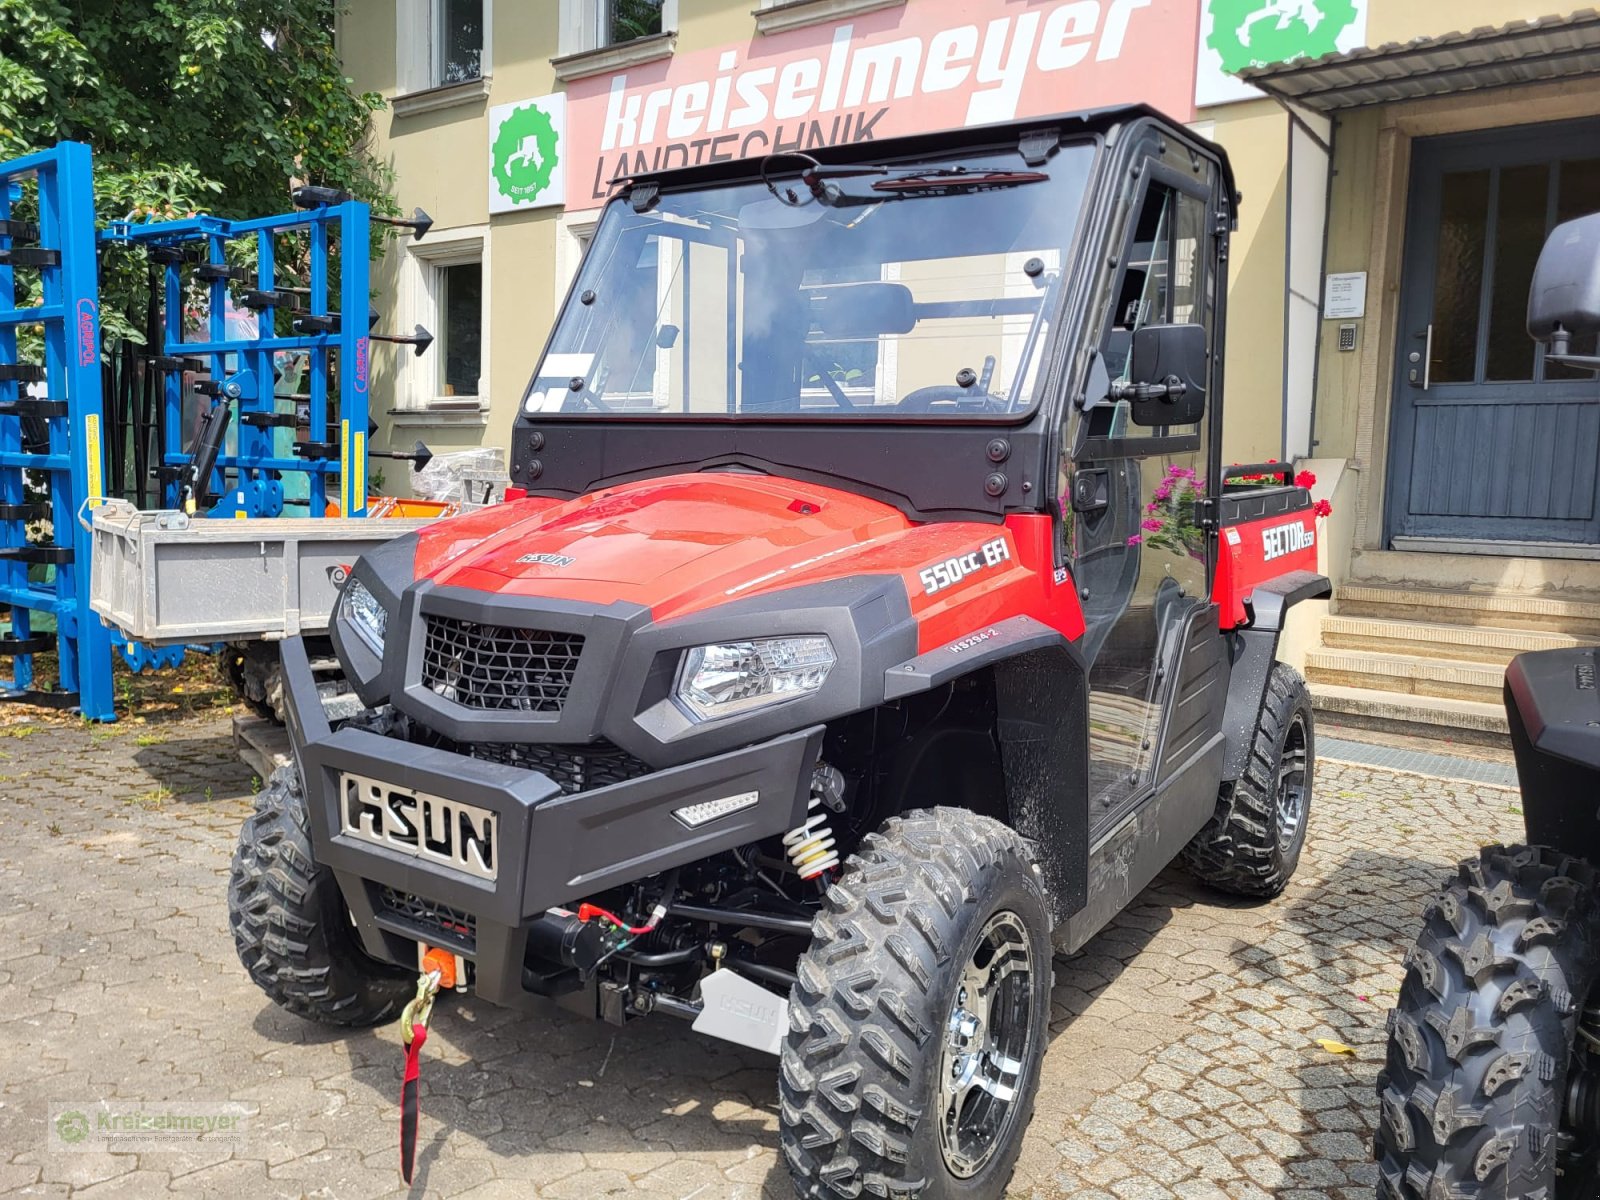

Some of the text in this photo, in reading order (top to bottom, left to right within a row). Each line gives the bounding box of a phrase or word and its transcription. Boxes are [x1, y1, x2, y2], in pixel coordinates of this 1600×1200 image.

[601, 0, 1152, 150] kreiselmeyer
[1262, 521, 1305, 561] SECTOR
[919, 537, 1010, 594] 550cc EFI
[1054, 567, 1067, 582] EPS
[950, 629, 999, 653] HS294-2
